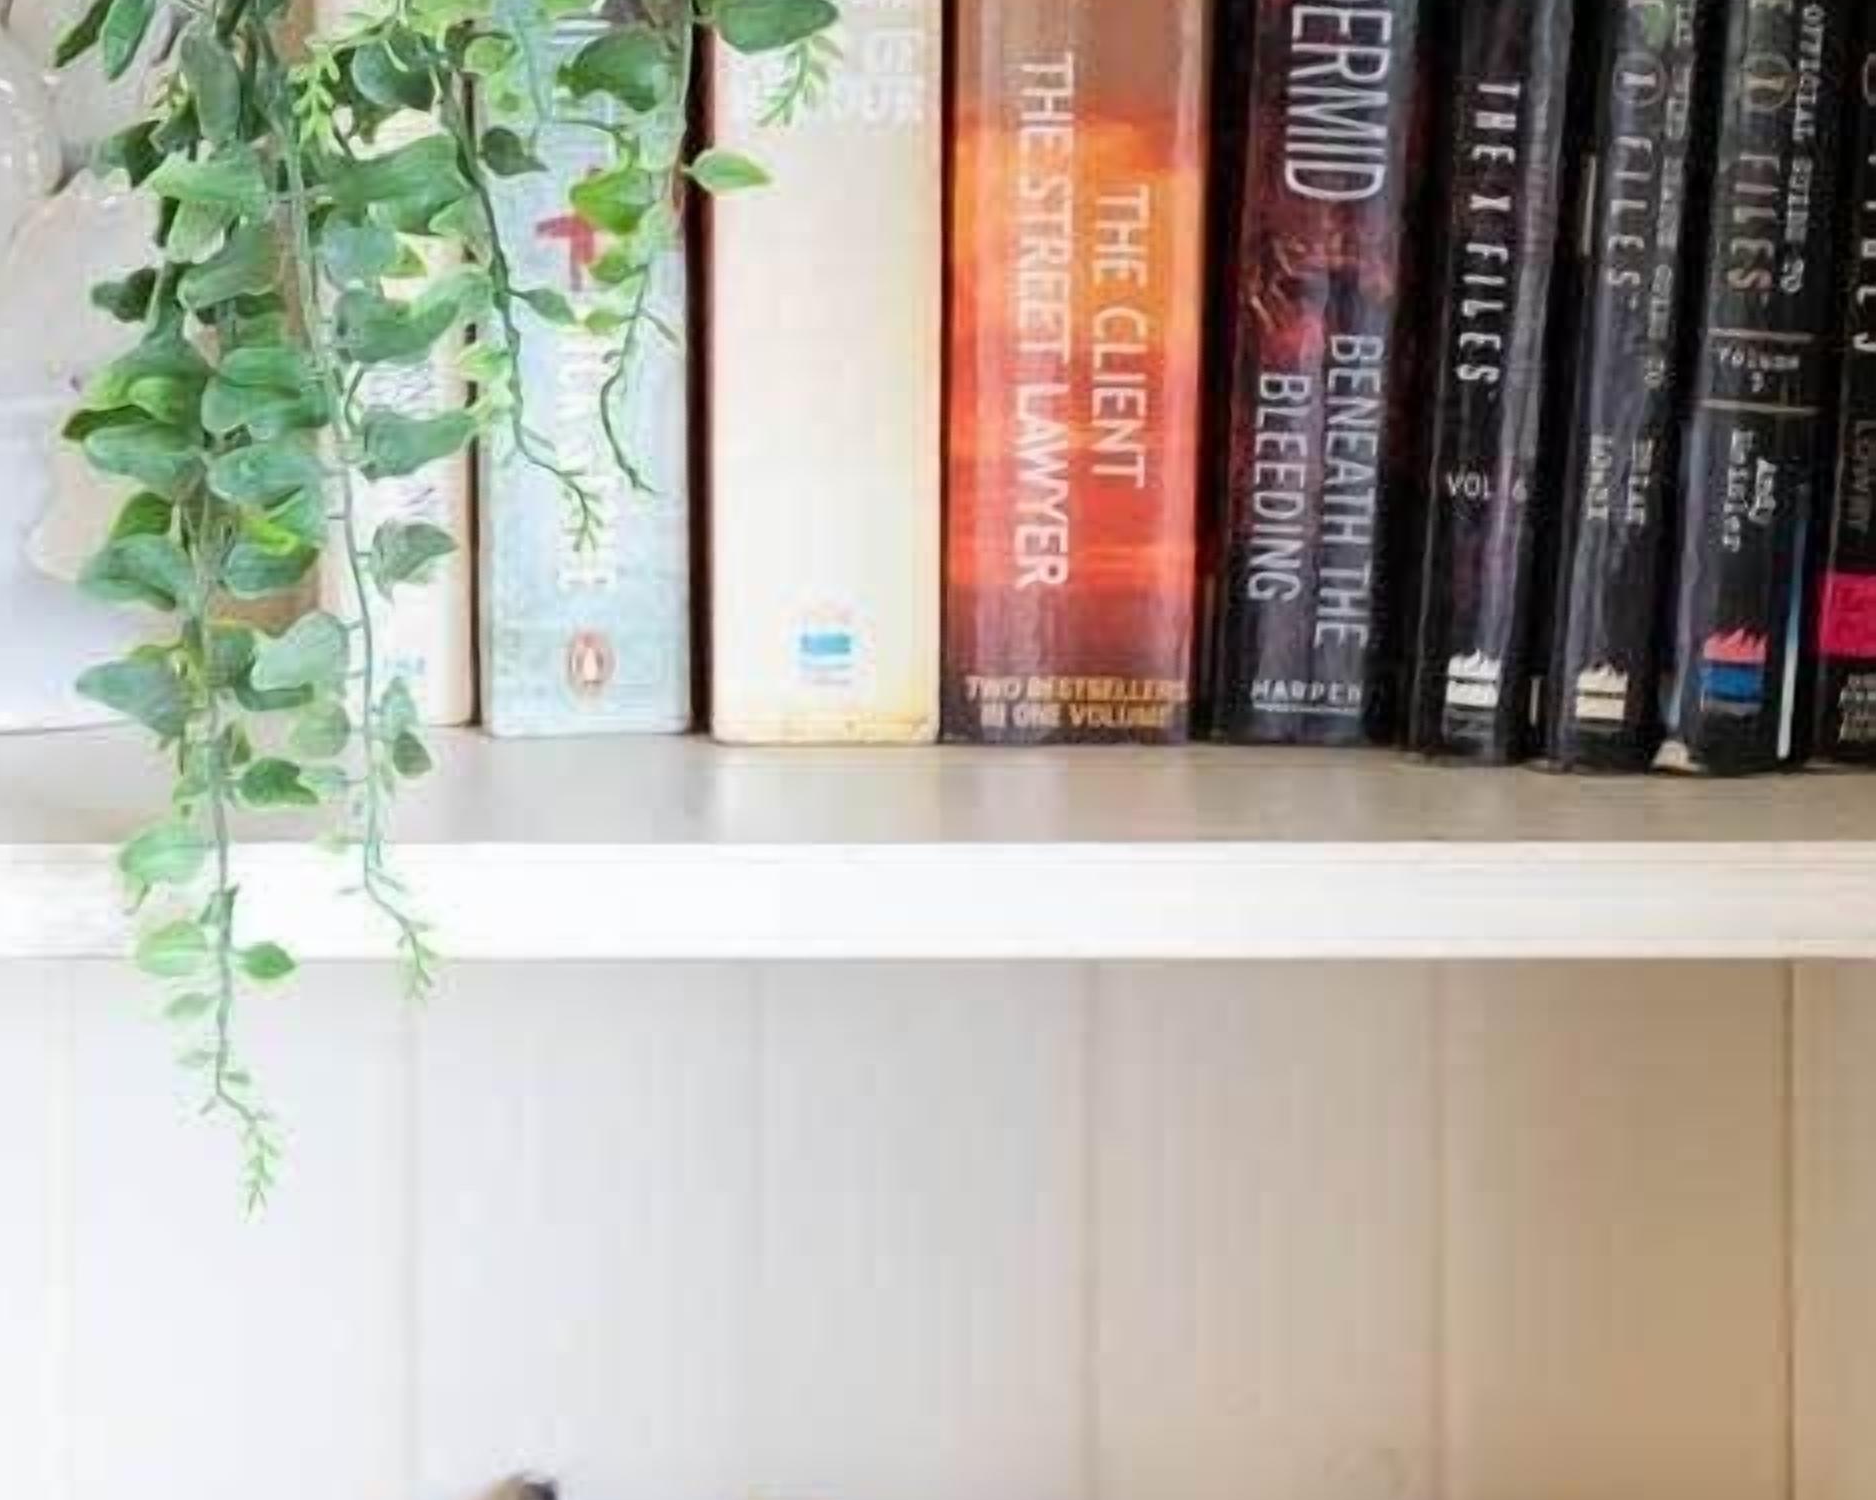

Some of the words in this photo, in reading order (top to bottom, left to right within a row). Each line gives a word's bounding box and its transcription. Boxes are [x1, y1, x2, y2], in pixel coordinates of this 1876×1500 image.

[1020, 51, 1075, 162] THE
[1470, 81, 1521, 163] THE
[1018, 170, 1074, 363] STREET
[1102, 183, 1150, 291] THE
[1469, 194, 1513, 212] X
[1604, 135, 1655, 290] FILES
[1728, 152, 1781, 291] FILES
[1455, 241, 1510, 385] FILES
[1090, 305, 1147, 490] CLIENT
[1321, 333, 1385, 543] BENEATH
[1012, 374, 1070, 592] LAWYER
[1247, 371, 1314, 602] BLEEDING
[1314, 556, 1372, 649] THE
[966, 676, 1020, 700] TWO
[1069, 703, 1171, 728] VOLUME
